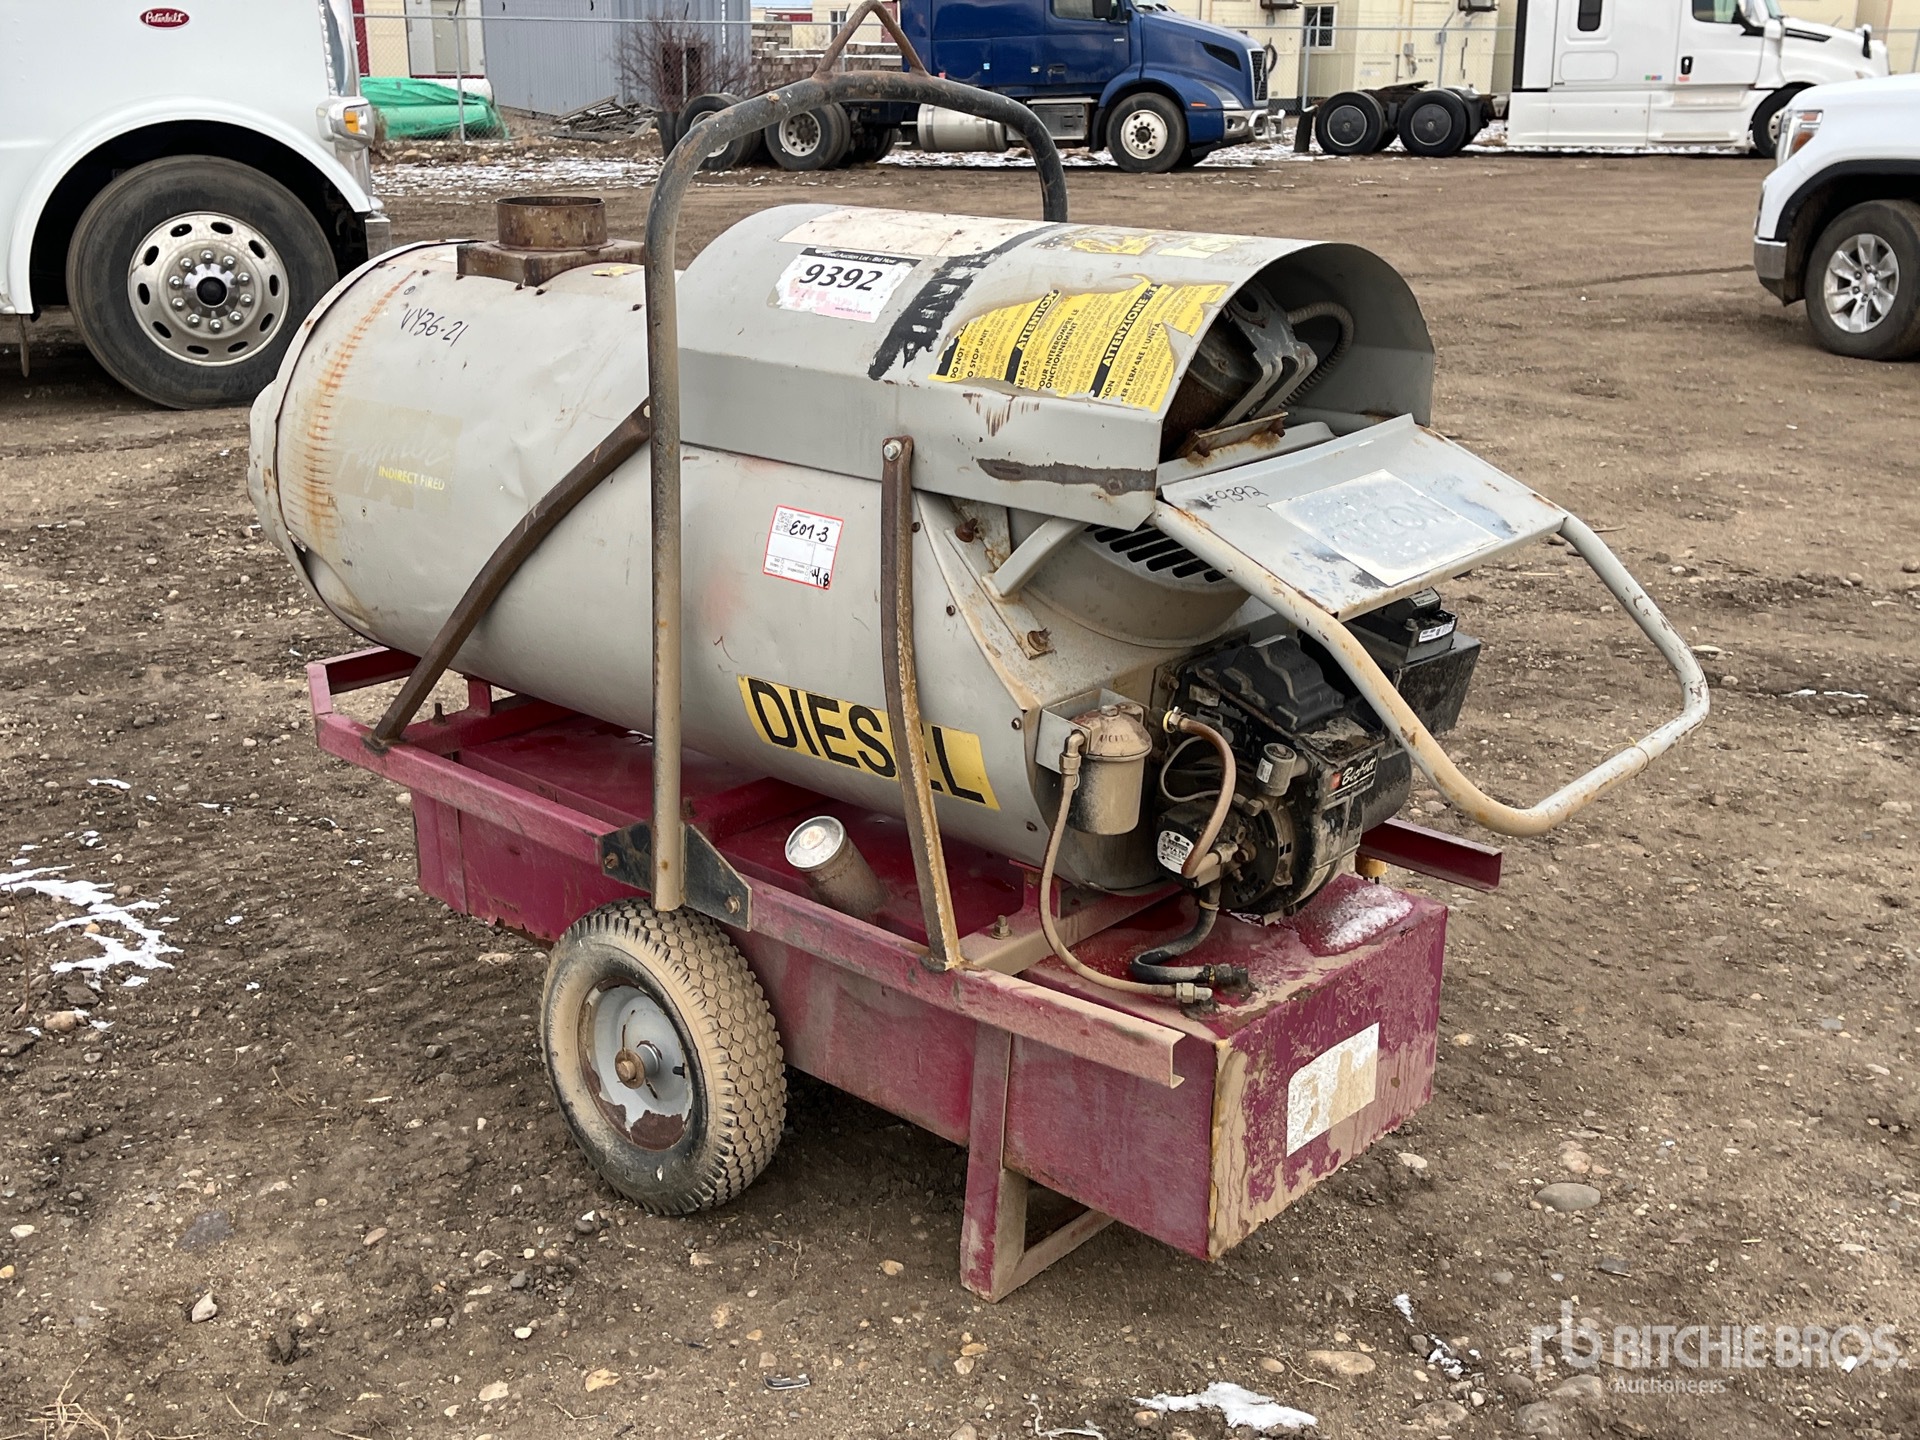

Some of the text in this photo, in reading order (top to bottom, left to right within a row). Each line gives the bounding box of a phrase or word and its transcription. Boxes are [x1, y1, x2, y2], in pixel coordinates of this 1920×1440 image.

[145, 11, 185, 24] Peterbilt
[798, 263, 883, 291] 9392
[1014, 289, 1057, 351] ATTENTION
[1044, 315, 1074, 367] INTERROMPRE
[1070, 307, 1079, 316] LE
[1101, 295, 1148, 367] ATTENZIONE
[949, 365, 959, 379] DO
[954, 346, 965, 365] NOT
[968, 347, 981, 369] STOP
[976, 328, 989, 347] UNIT
[1019, 358, 1030, 376] PAS
[1044, 321, 1078, 389] ONCTIONNEMENT
[378, 465, 445, 491] INDIRECT FIRED
[748, 678, 986, 804] DIESL
